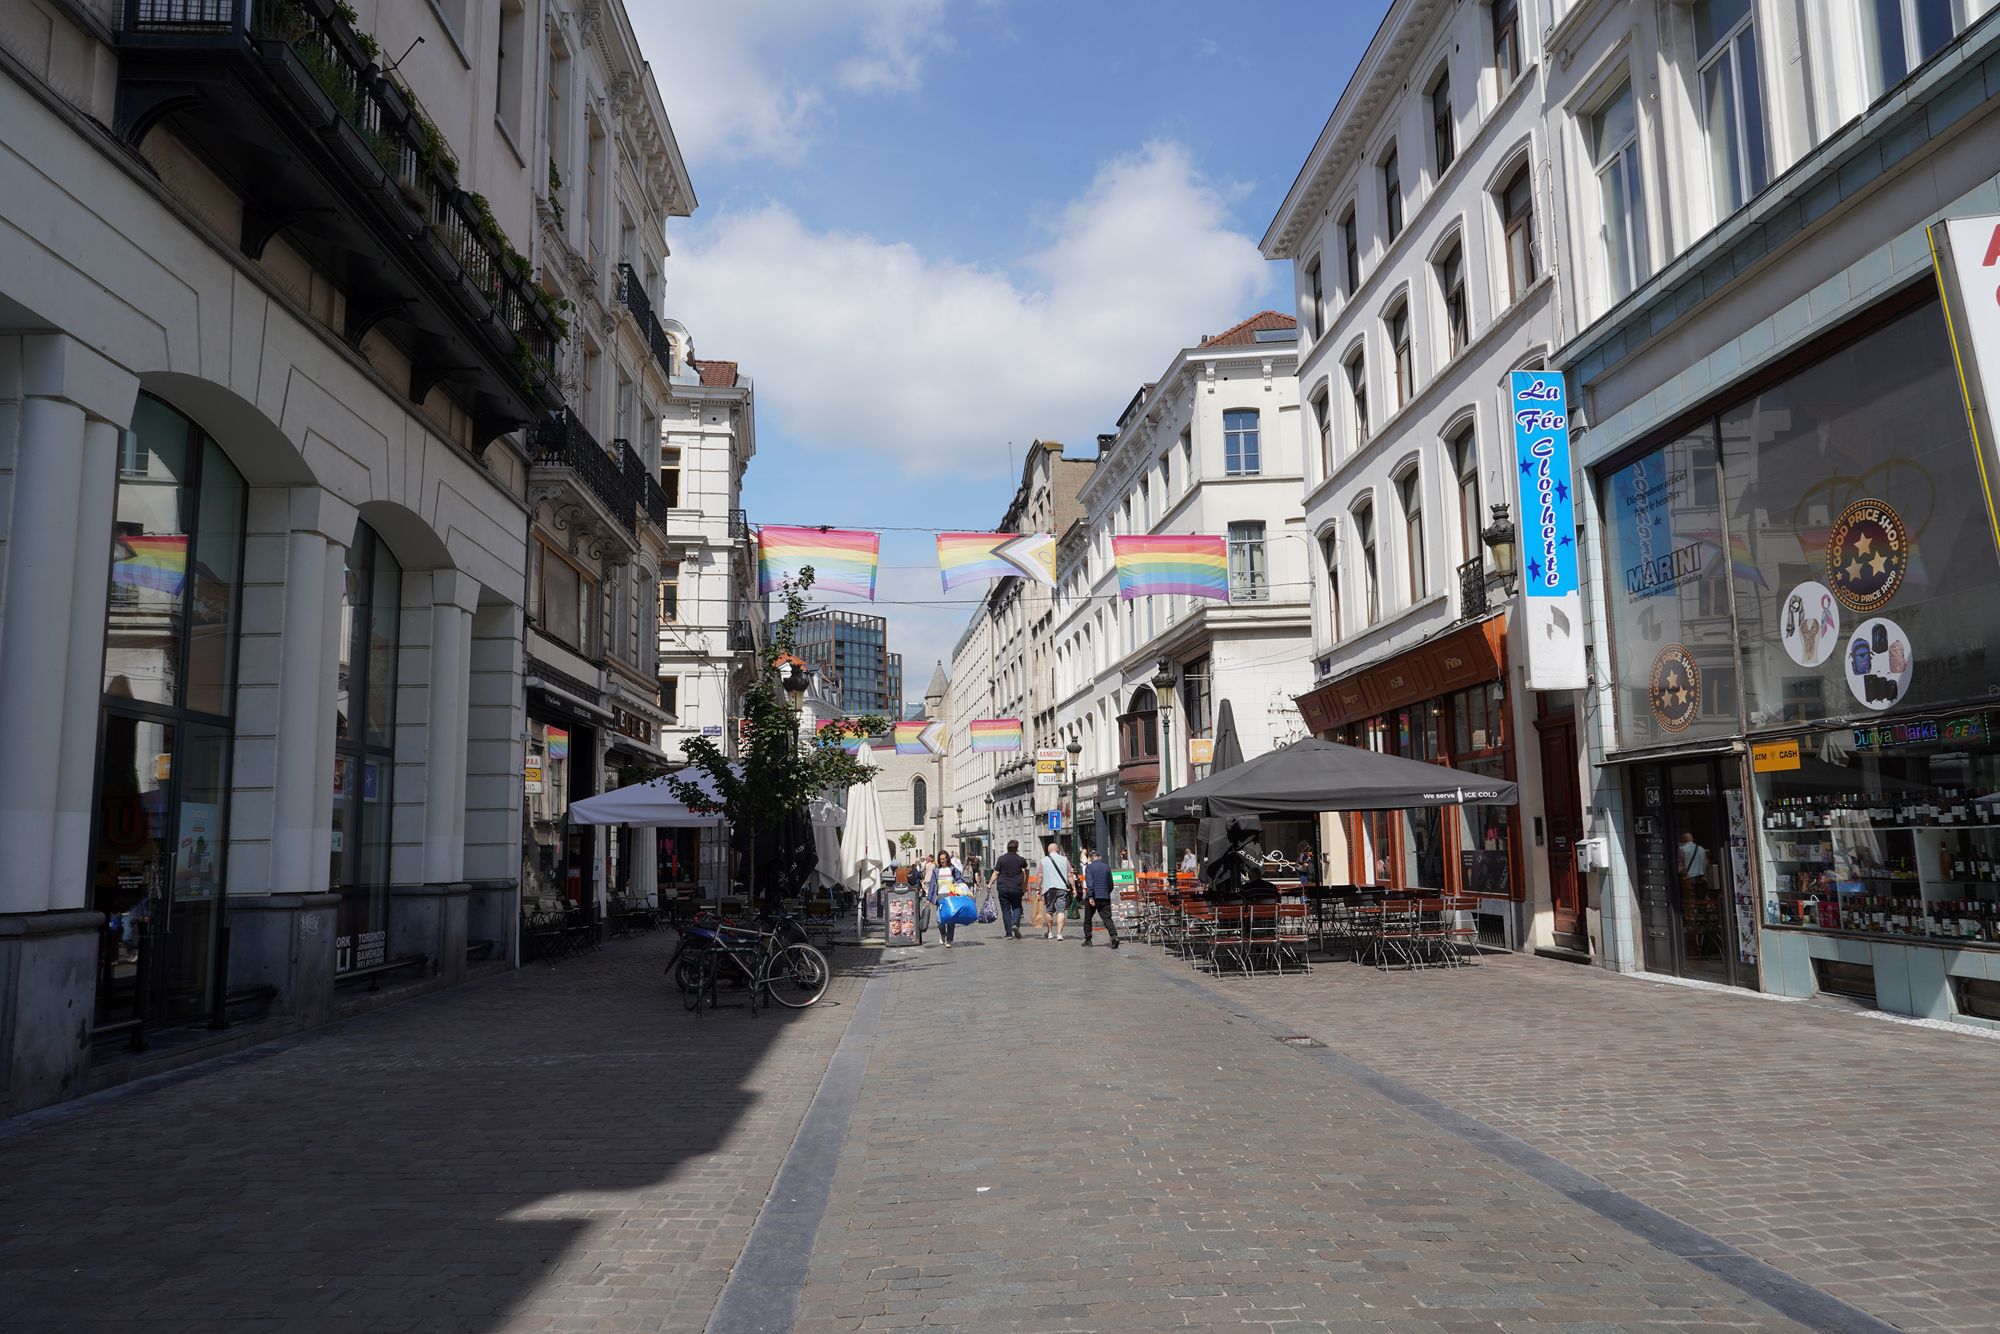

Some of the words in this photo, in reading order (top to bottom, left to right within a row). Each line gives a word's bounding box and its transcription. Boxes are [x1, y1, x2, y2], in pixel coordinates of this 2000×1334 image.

[1518, 380, 1560, 401] La
[1516, 409, 1566, 434] Fée
[1531, 437, 1559, 587] Clochette
[1653, 516, 1662, 527] de
[1833, 525, 1849, 567] GOOD
[1848, 508, 1880, 528] PRICE
[1878, 515, 1900, 551] SHOP
[1627, 542, 1702, 595] MARINI
[1841, 585, 1860, 603] GOOD
[1860, 588, 1882, 603] PRICE
[1881, 570, 1896, 594] SHOP
[1653, 662, 1663, 696] GOOD
[1662, 651, 1682, 665] PRICE
[1681, 657, 1695, 686] SHOP
[1854, 728, 1893, 747] Dunya
[1945, 723, 1977, 739] OPEN
[1754, 752, 1767, 761] ATM
[1779, 749, 1798, 759] CASH
[1648, 790, 1659, 804] 34
[336, 936, 351, 948] ORK
[357, 931, 386, 944] TORONTO
[356, 947, 385, 961] BANGKOK
